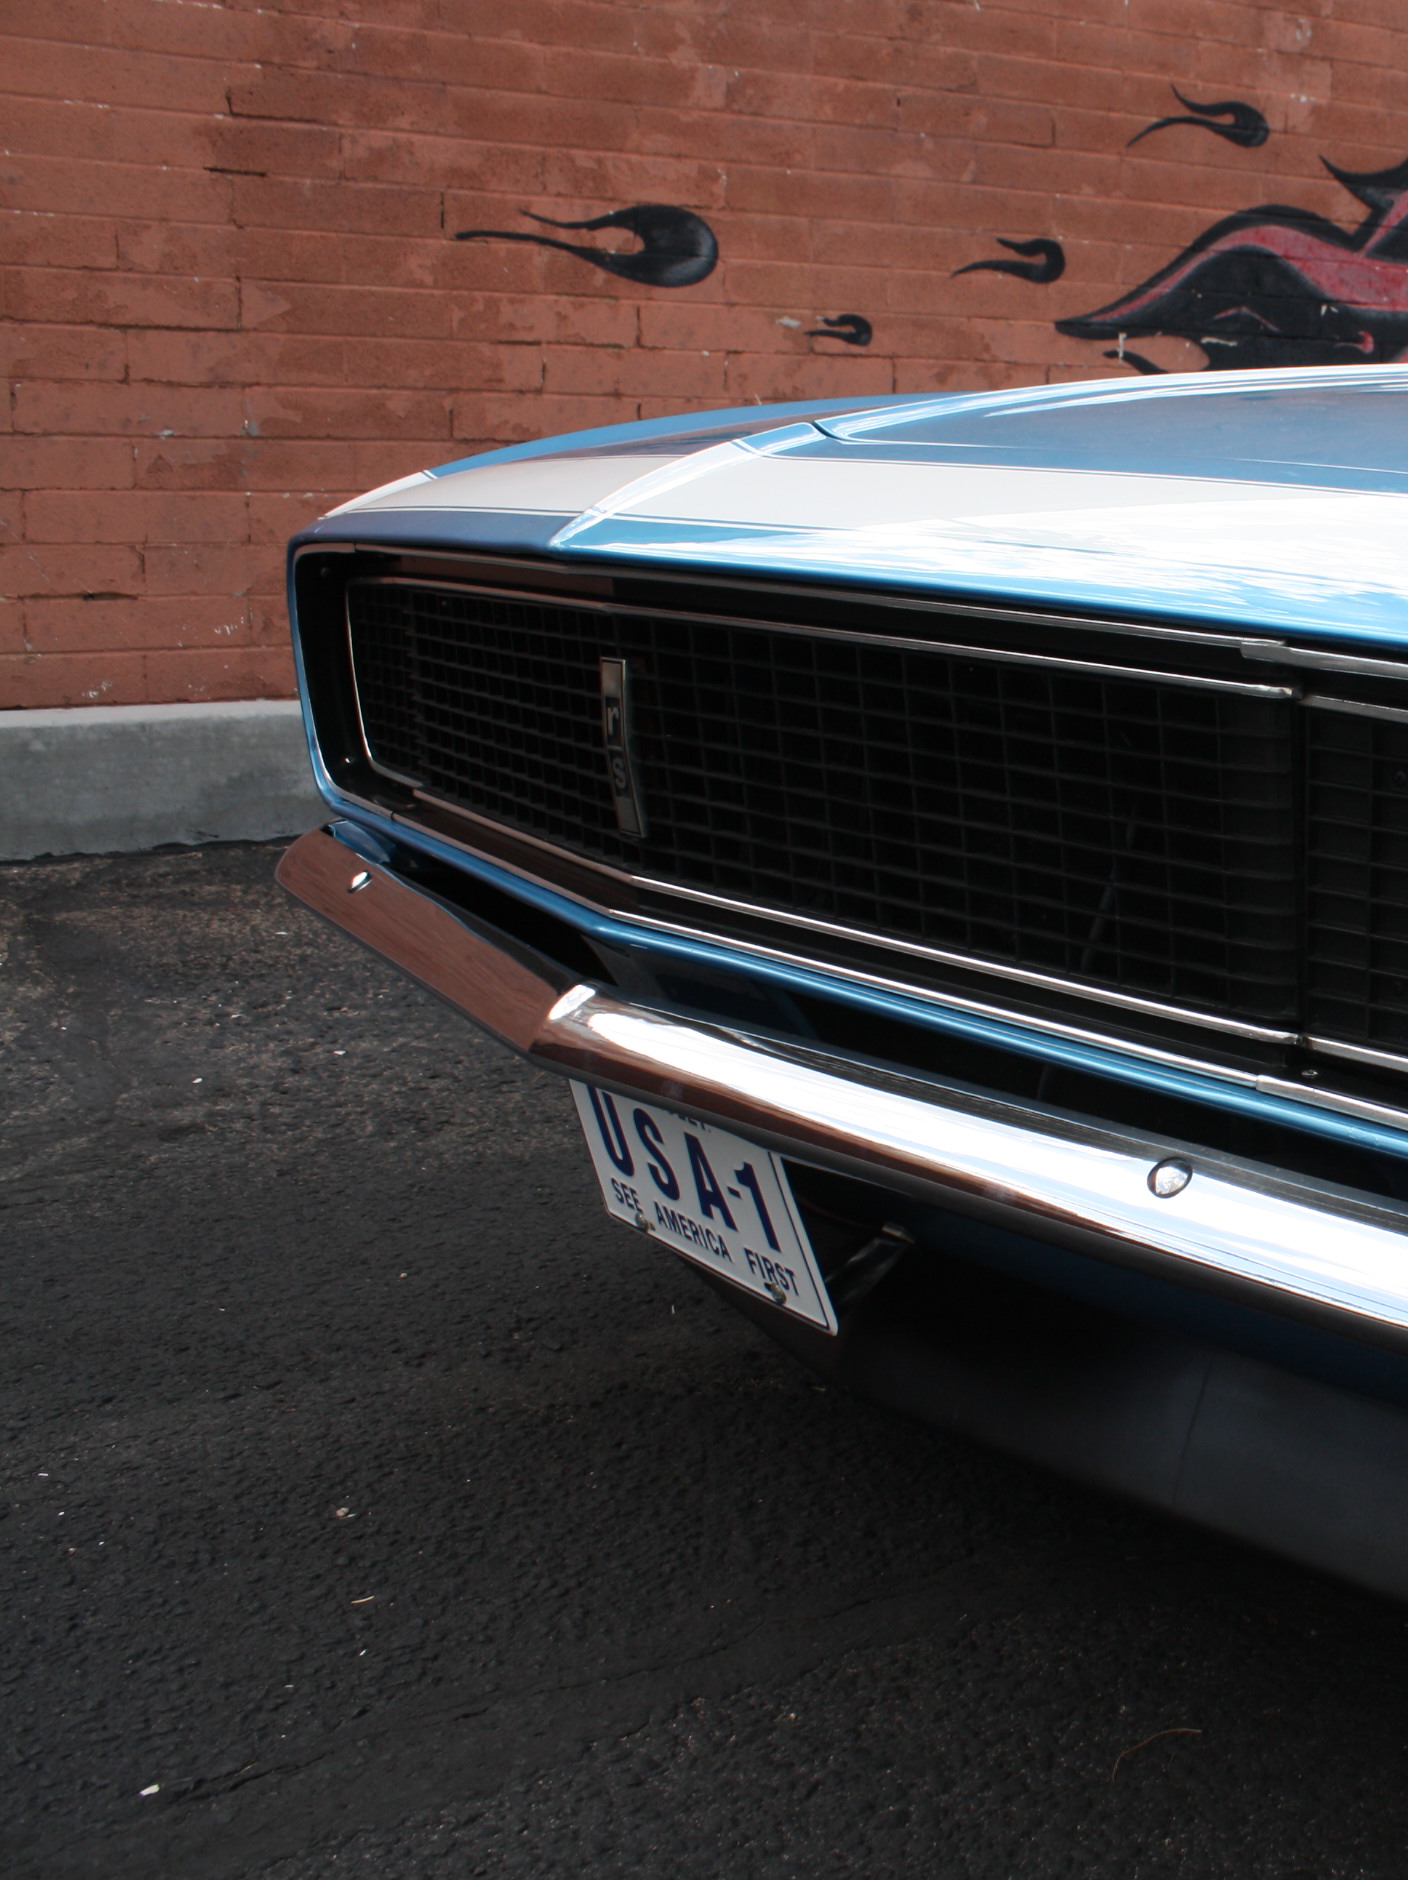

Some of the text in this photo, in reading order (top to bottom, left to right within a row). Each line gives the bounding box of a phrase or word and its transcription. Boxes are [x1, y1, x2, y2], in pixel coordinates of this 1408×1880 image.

[587, 1084, 782, 1253] USA-1
[610, 1177, 800, 1297] SEE AMERICA FIRST
